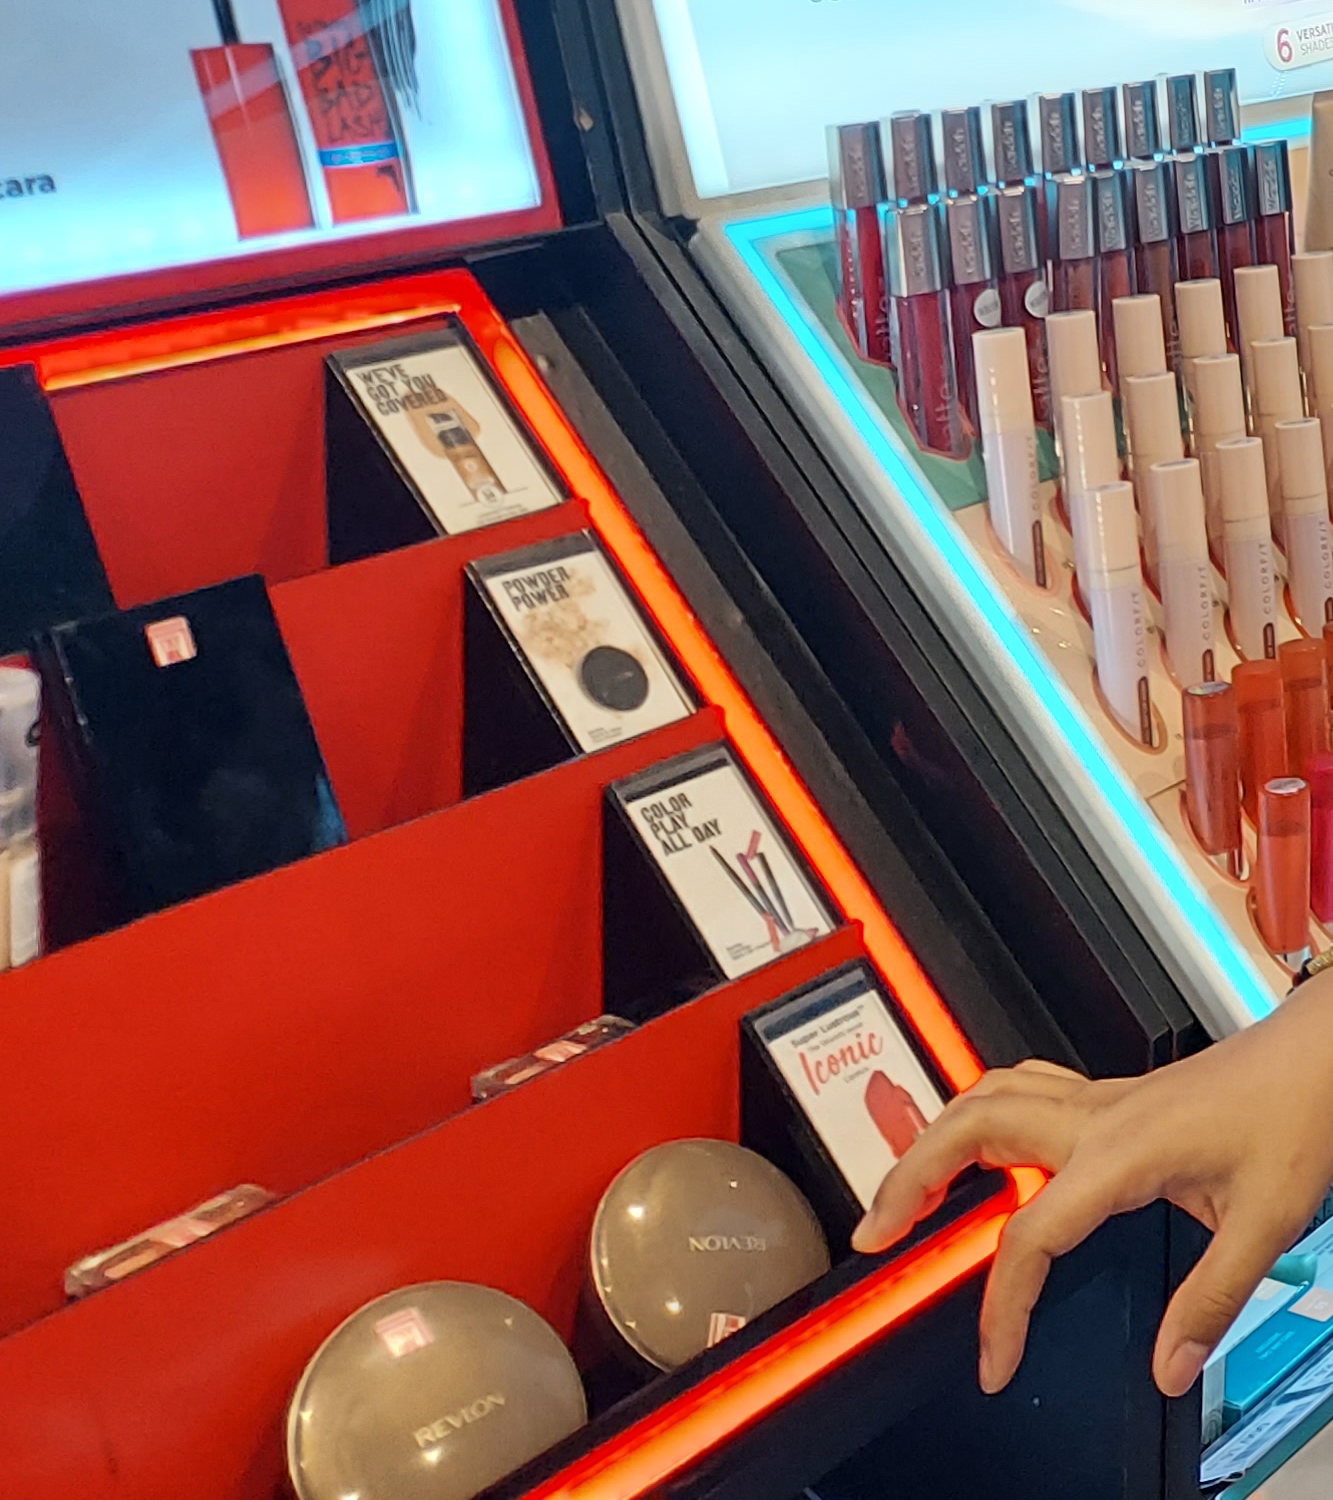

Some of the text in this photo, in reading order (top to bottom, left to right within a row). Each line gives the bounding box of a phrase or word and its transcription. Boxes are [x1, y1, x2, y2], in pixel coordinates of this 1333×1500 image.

[1277, 27, 1293, 63] 6
[367, 374, 437, 401] GOT YOU
[376, 388, 448, 417] COVERED
[503, 567, 570, 596] POWDER
[512, 585, 570, 612] POWER
[640, 792, 692, 823] COLOR
[649, 816, 691, 840] PLAY
[660, 819, 722, 856] ALL DAY
[799, 1032, 883, 1096] Iconic
[412, 1393, 507, 1449] REVLON
